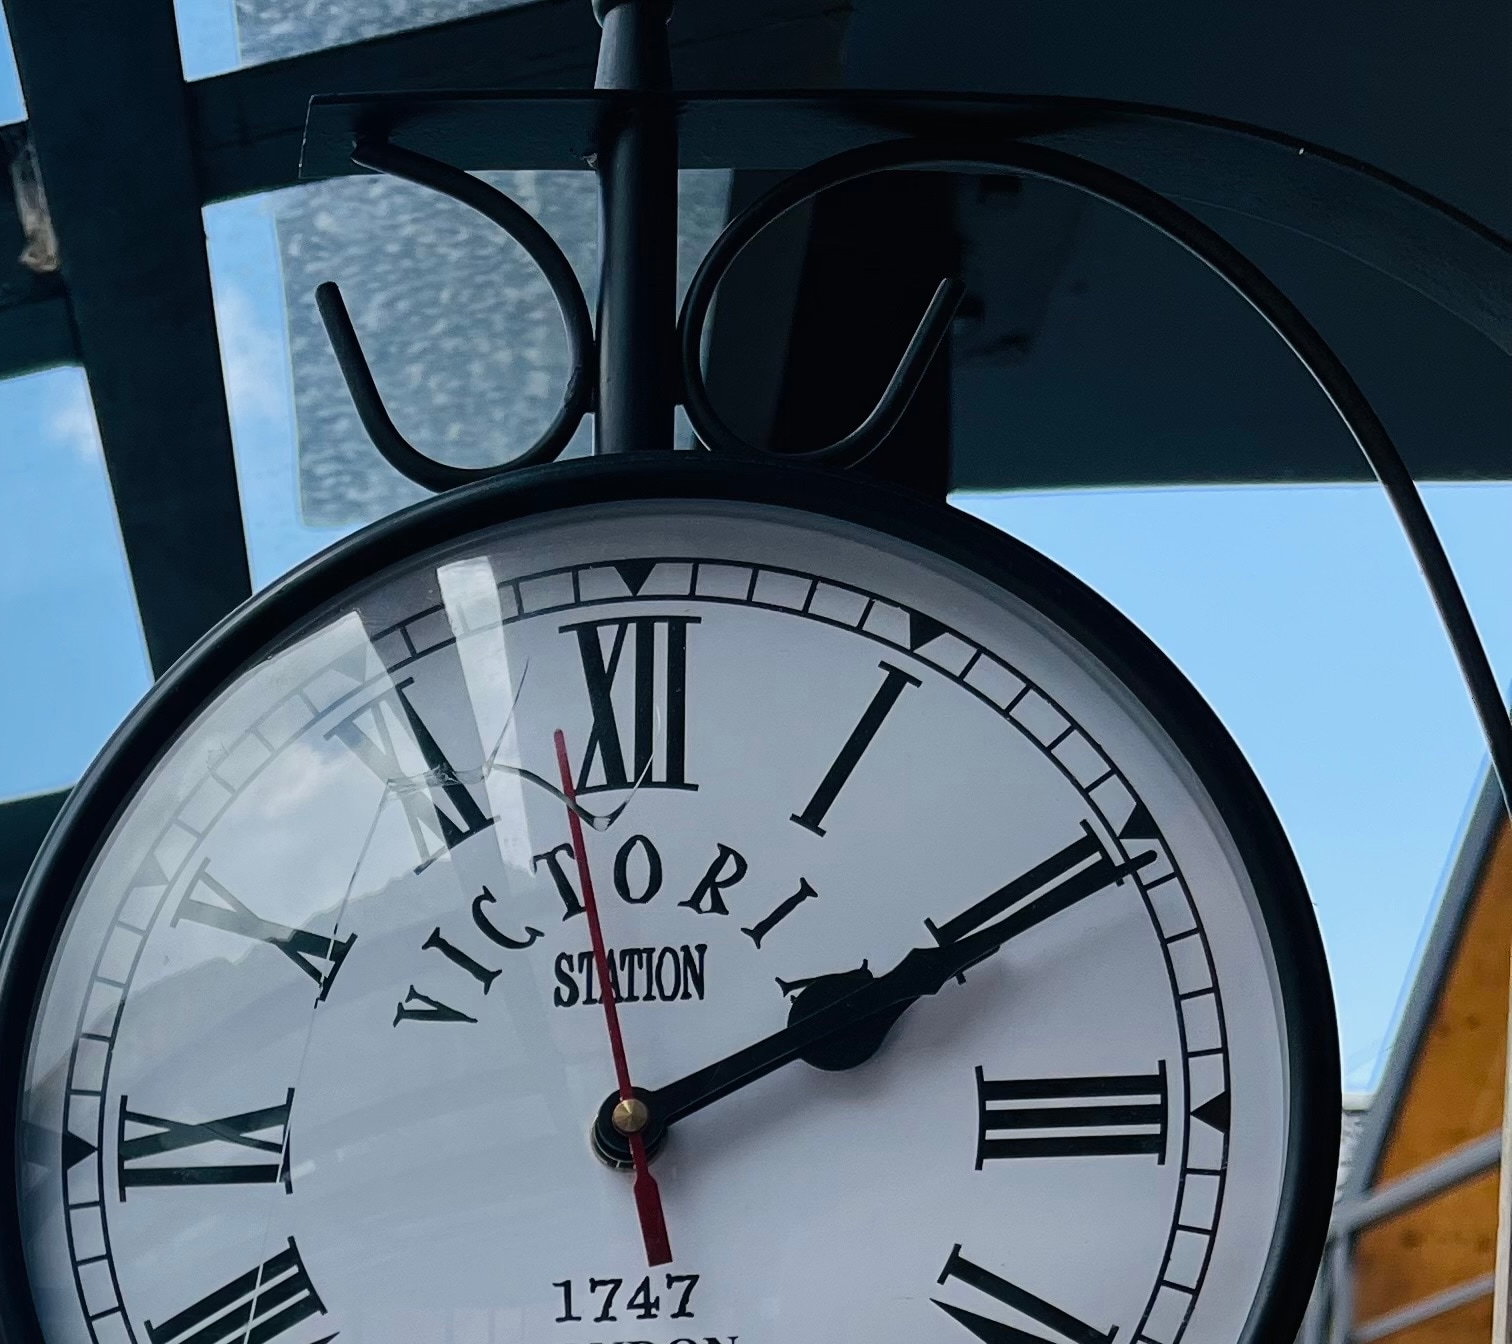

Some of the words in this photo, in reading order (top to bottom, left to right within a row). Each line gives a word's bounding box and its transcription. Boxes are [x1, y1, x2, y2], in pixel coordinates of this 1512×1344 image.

[559, 615, 701, 794] XII
[790, 660, 922, 837] I
[324, 677, 500, 875] XI
[169, 857, 358, 1001] X
[553, 943, 708, 1008] STATION
[117, 1087, 296, 1203] IX
[974, 1059, 1168, 1171] III
[551, 1274, 701, 1323] 1747
